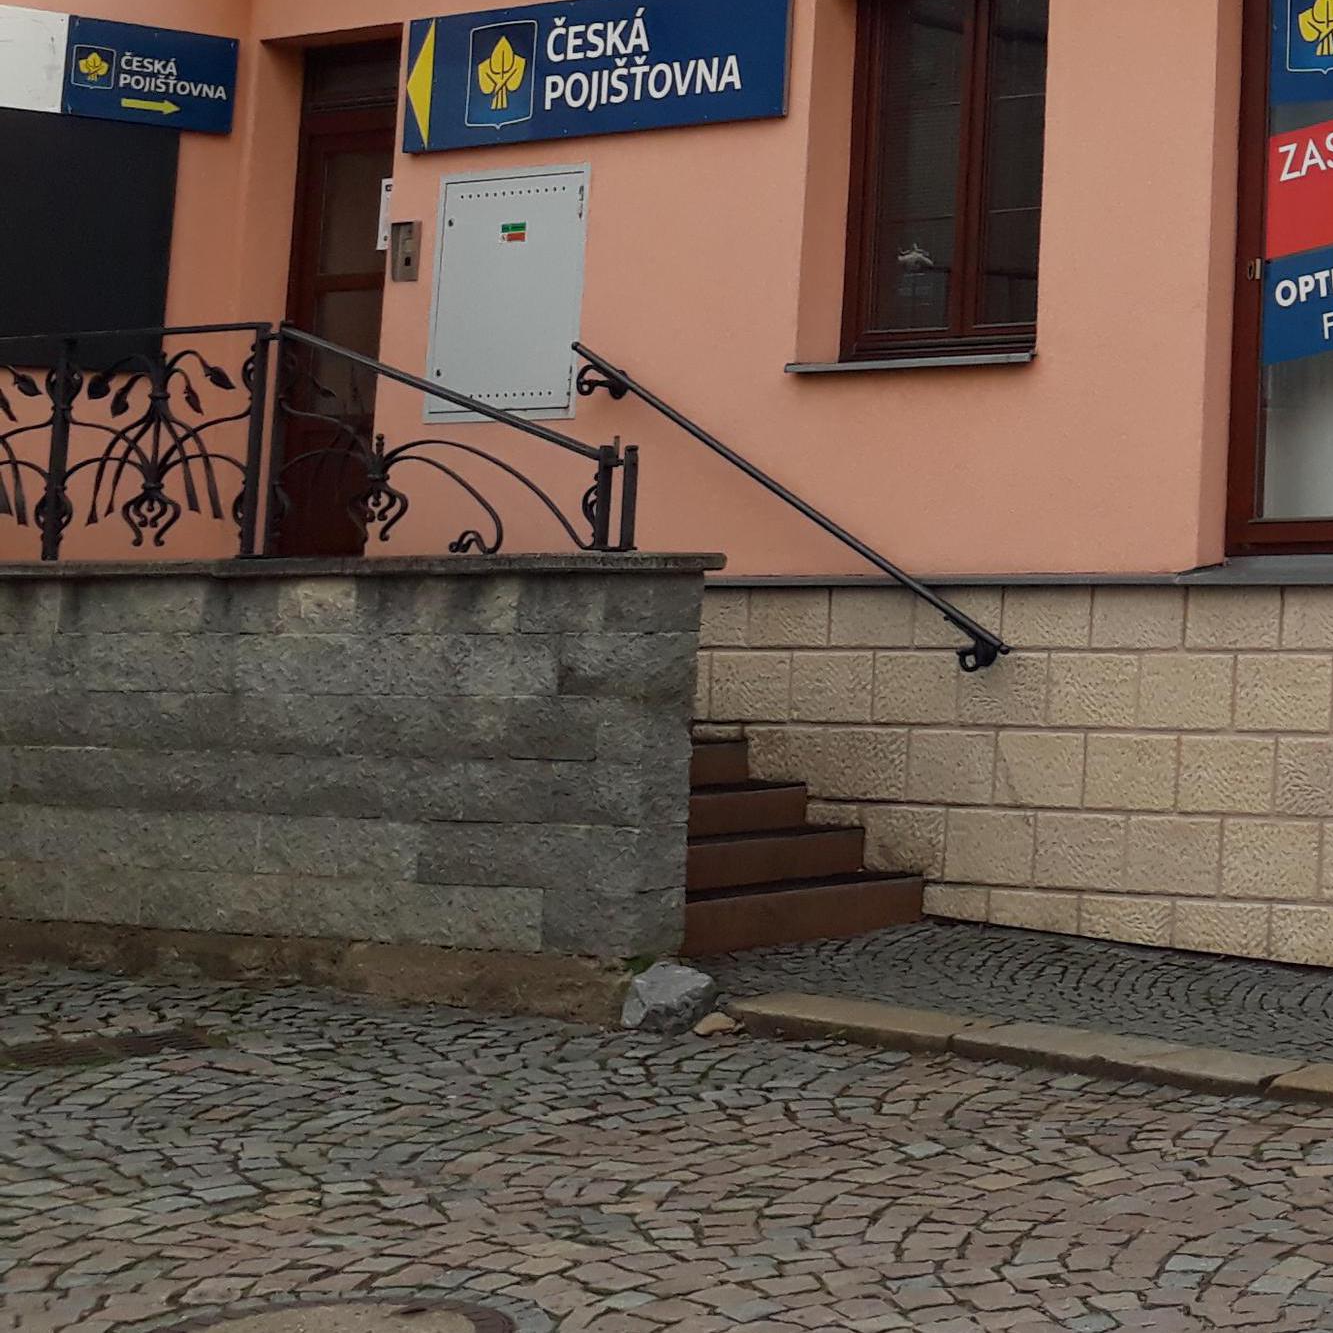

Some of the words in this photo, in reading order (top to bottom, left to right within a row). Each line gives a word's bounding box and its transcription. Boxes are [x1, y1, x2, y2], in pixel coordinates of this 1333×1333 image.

[546, 7, 650, 62] ČESKÁ
[120, 52, 178, 76] ČESKÁ
[543, 52, 743, 112] POJIŠŤOVNA
[119, 73, 228, 100] POJIŠŤOVNA
